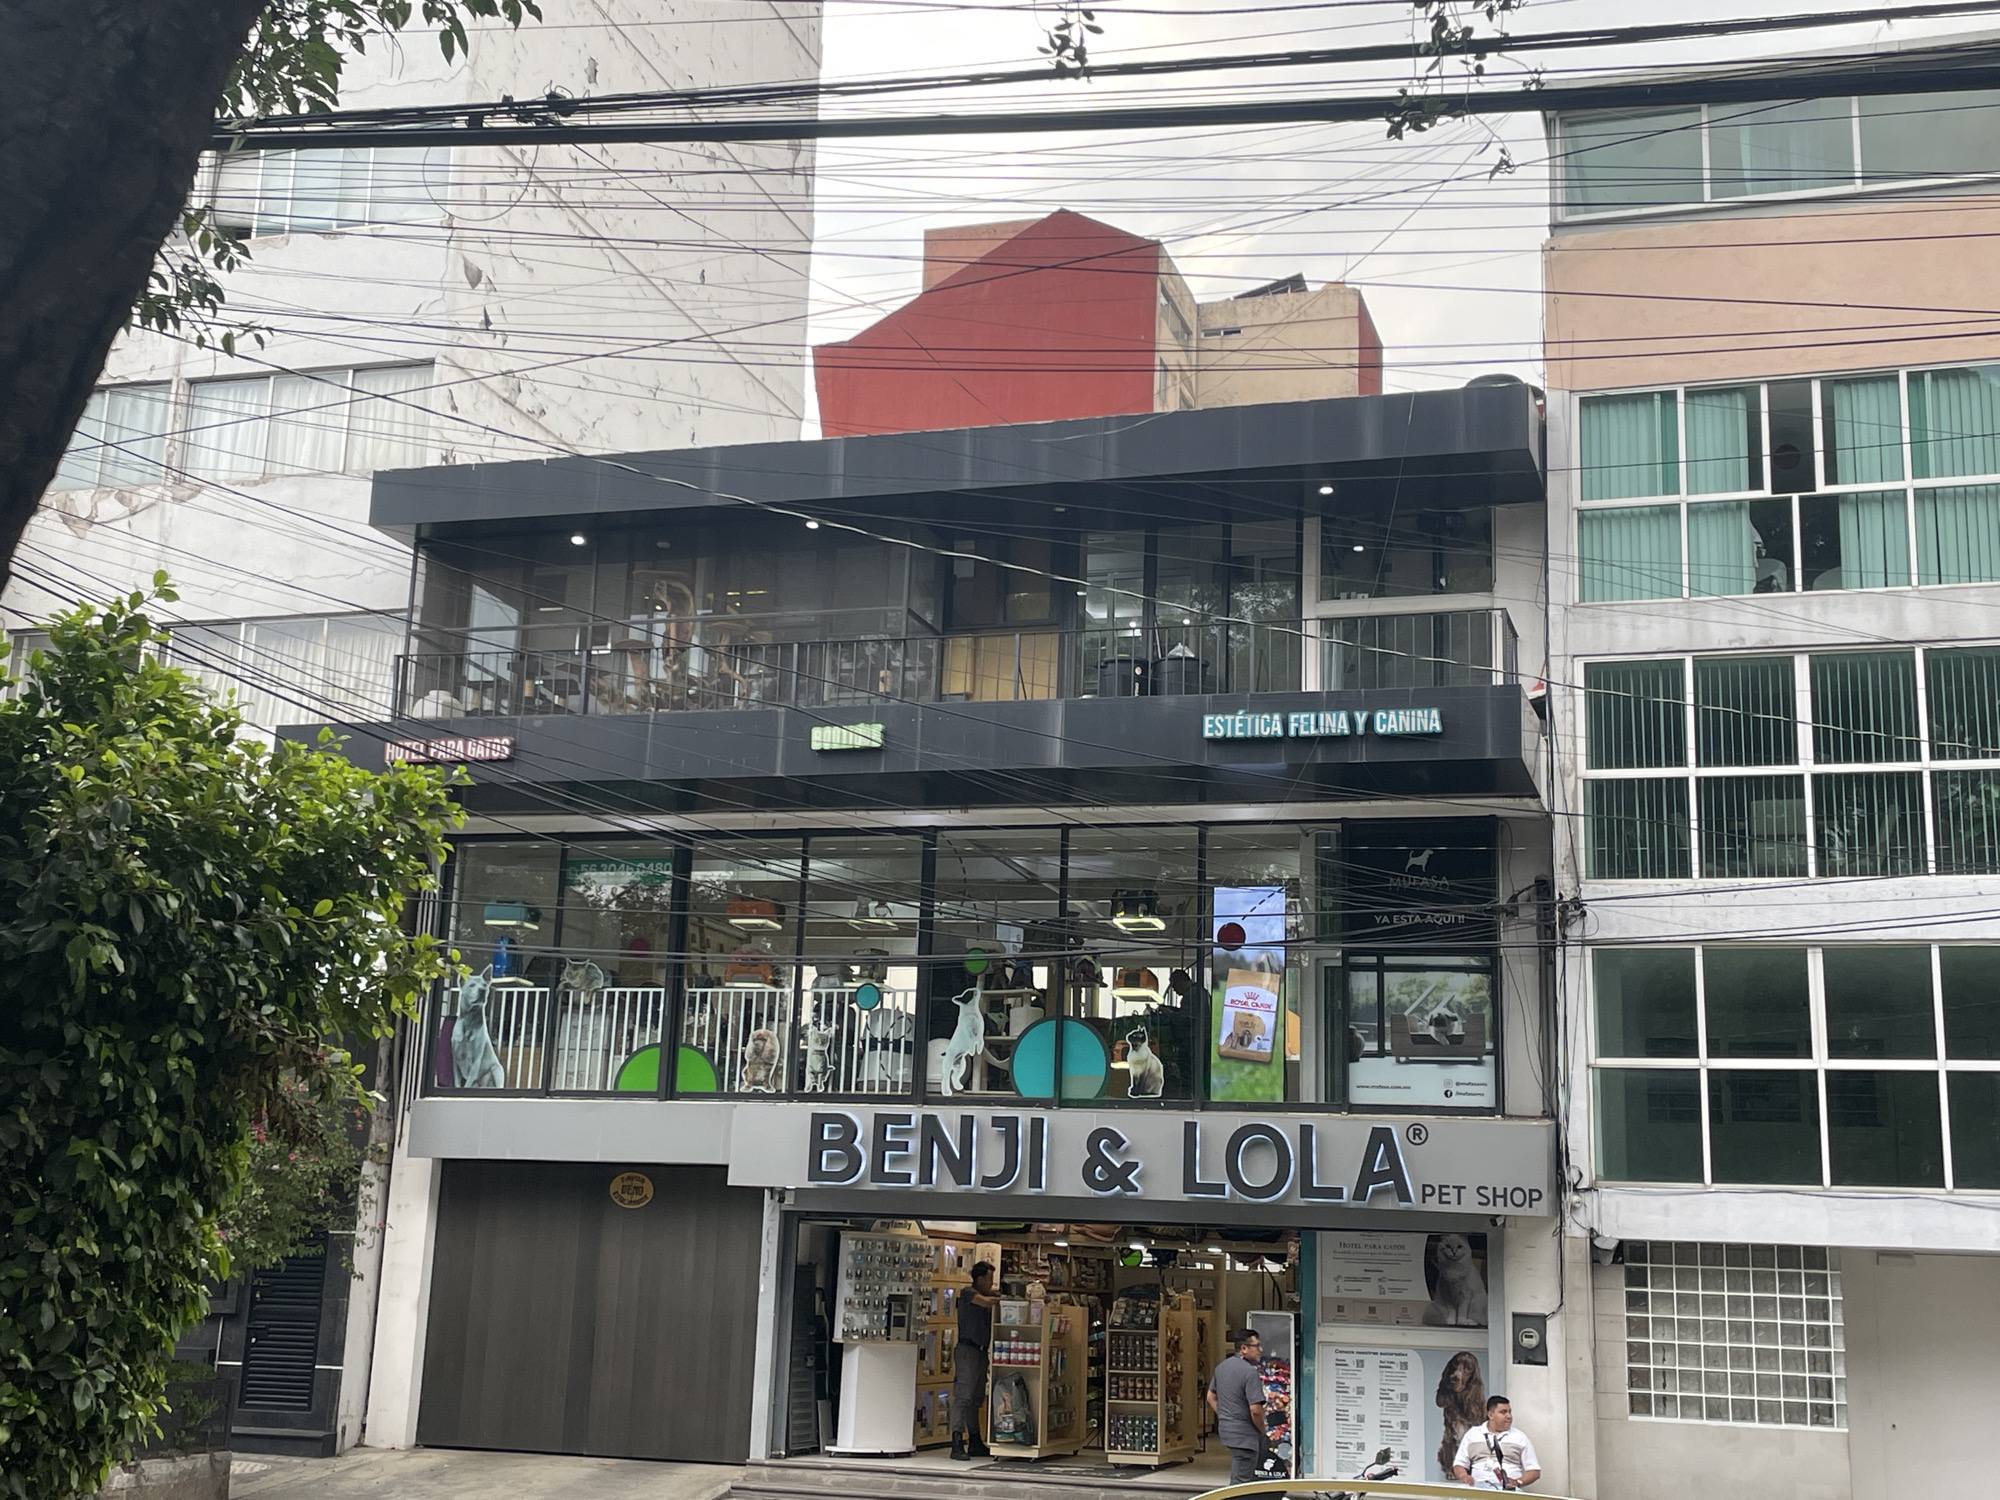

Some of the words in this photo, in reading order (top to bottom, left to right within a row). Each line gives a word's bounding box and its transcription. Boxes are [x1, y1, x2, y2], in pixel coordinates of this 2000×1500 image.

[1203, 709, 1283, 737] ESTÉTICA
[1289, 711, 1350, 735] FELINA
[1355, 711, 1368, 735] Y
[1375, 709, 1442, 734] CANINA
[385, 741, 427, 761] HOTEL
[429, 740, 464, 759] PARA
[467, 738, 511, 758] GATOS
[1388, 876, 1450, 887] MUFASA
[1374, 915, 1390, 924] YA
[808, 1111, 1048, 1191] BENJI
[1081, 1126, 1143, 1196] &
[1422, 1184, 1467, 1206] PET
[1476, 1185, 1544, 1209] SHOP
